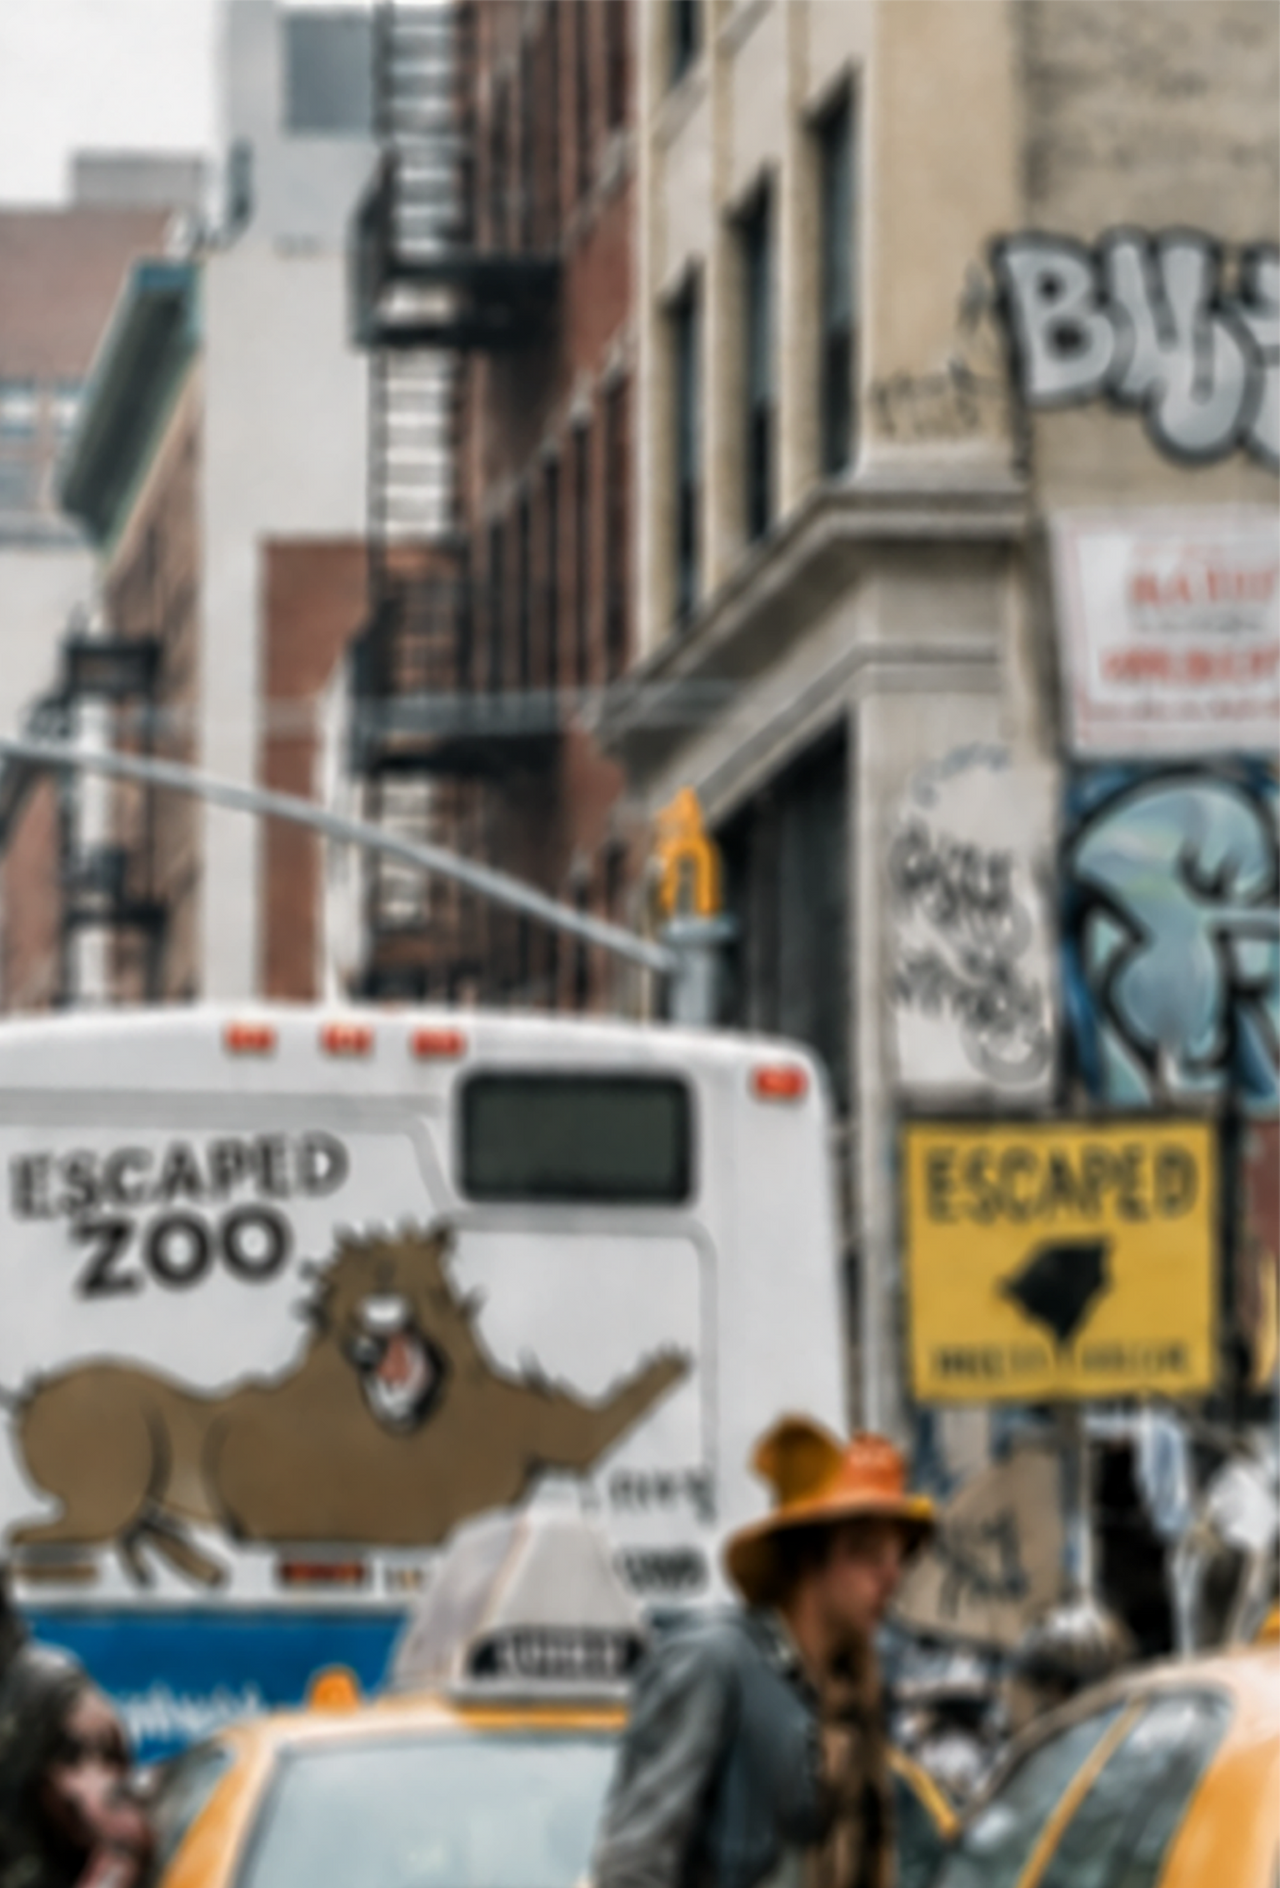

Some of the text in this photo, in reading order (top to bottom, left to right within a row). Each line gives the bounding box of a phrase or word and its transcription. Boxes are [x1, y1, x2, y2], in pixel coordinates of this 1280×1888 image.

[10, 1131, 349, 1218] ESCAPED
[924, 1142, 1198, 1226] ESCAPED
[72, 1205, 294, 1300] ZOO
